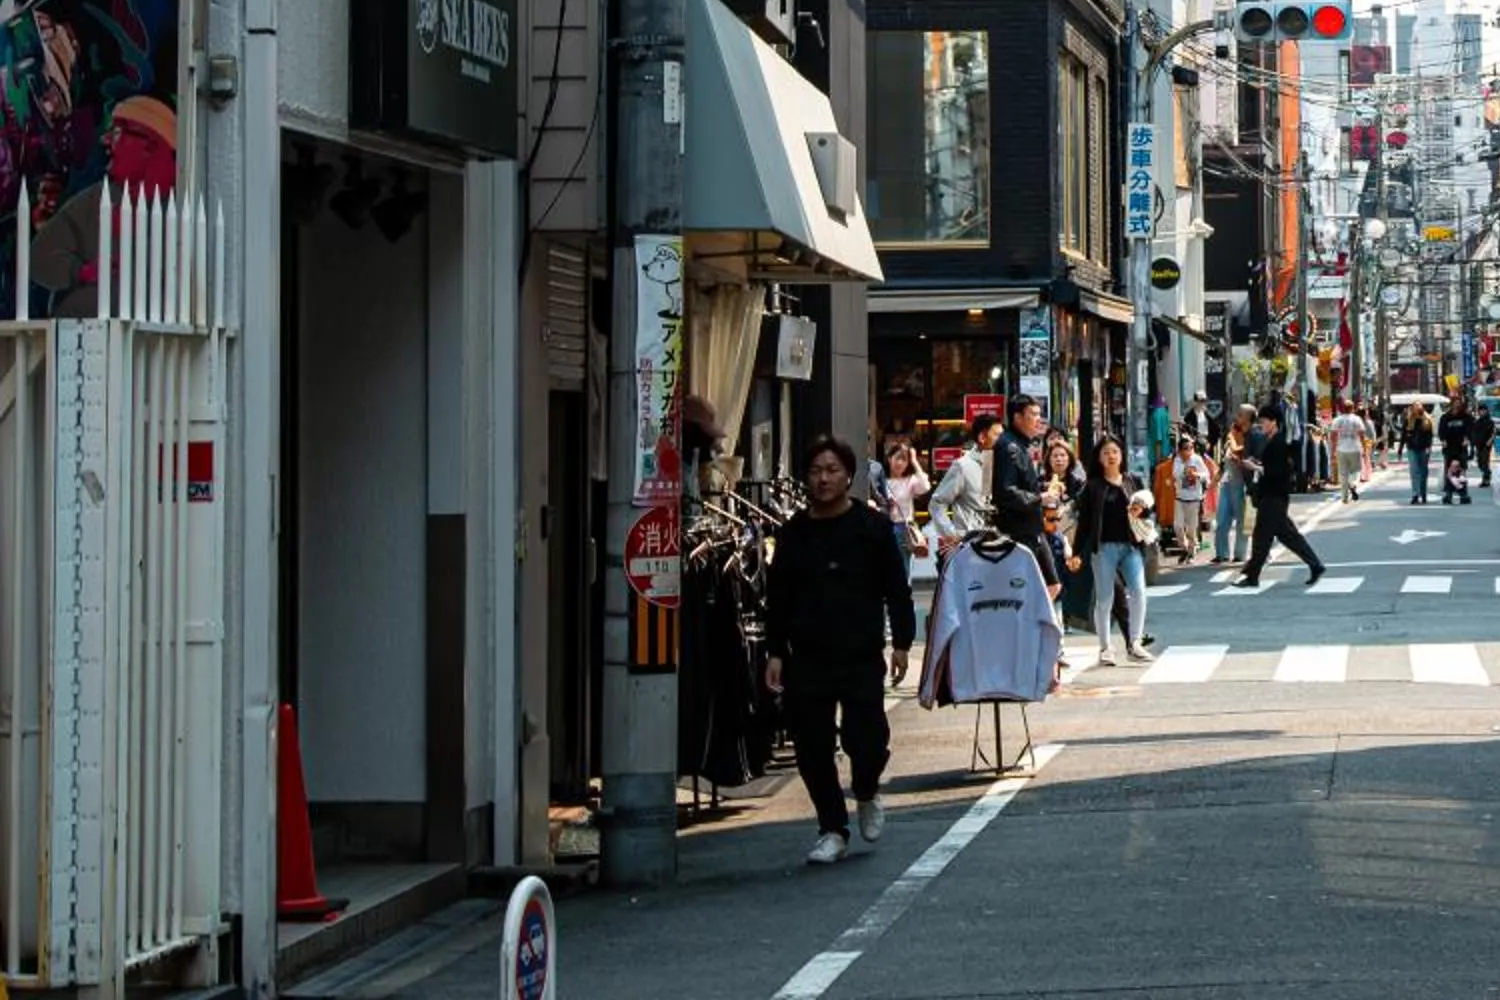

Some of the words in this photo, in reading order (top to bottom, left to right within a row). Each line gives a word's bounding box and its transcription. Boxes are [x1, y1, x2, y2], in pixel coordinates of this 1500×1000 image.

[1129, 127, 1153, 234] 歩車分離式
